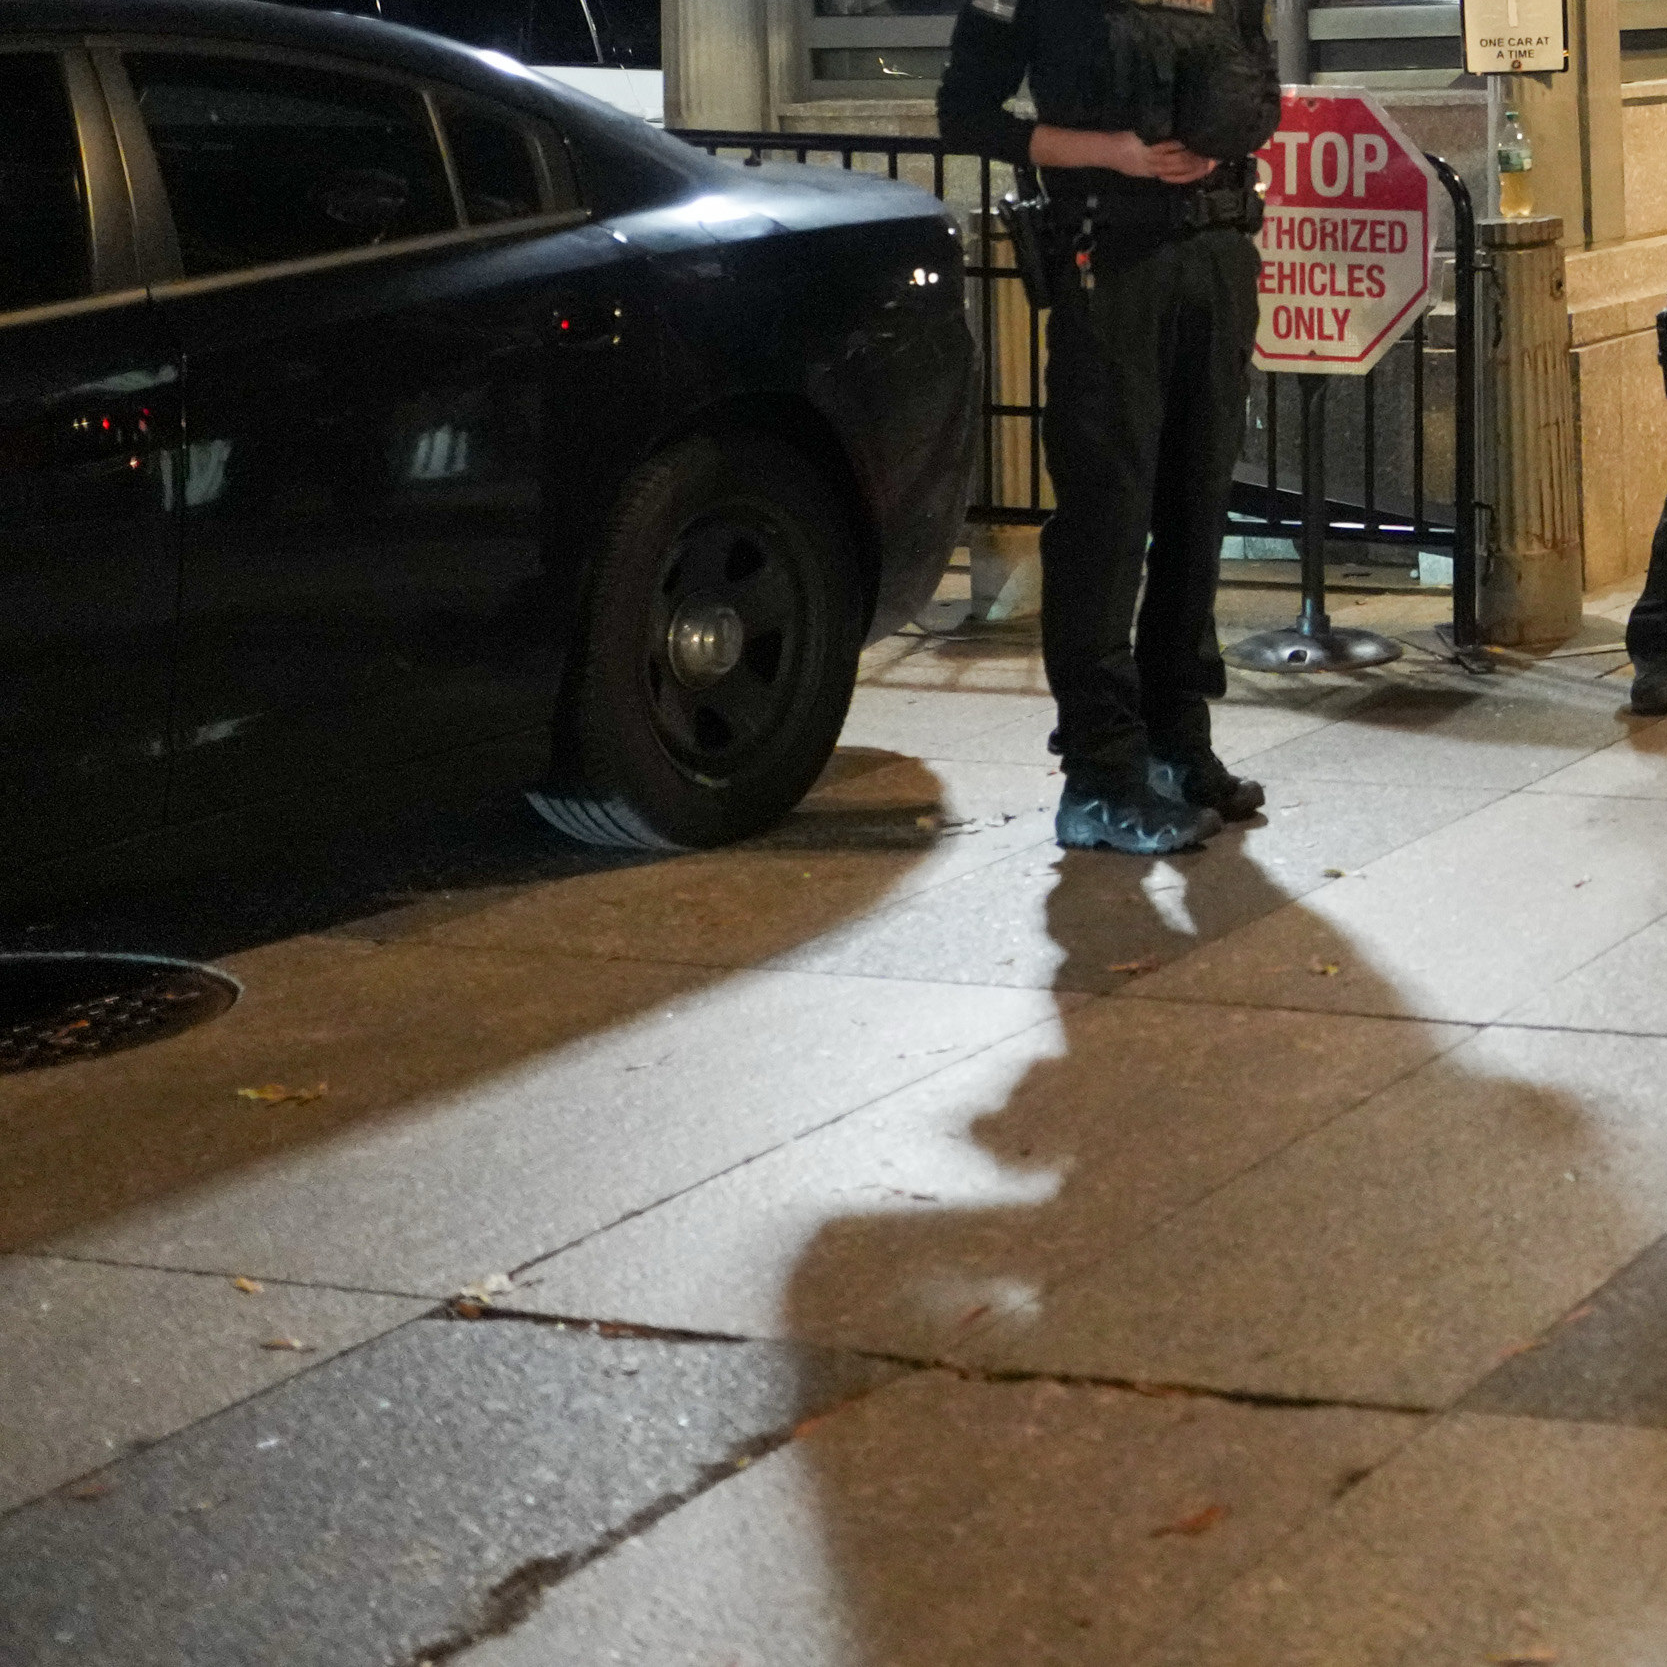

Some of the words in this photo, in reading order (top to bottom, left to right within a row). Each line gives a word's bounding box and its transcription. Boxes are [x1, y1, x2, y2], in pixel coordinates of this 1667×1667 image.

[1480, 38, 1505, 47] ONE
[1508, 37, 1532, 46] CAR
[1536, 36, 1550, 45] AT
[1496, 50, 1504, 59] A
[1508, 49, 1535, 59] TIME
[1262, 216, 1408, 254] THORIZED
[1258, 260, 1386, 298] EHICLES
[1272, 305, 1351, 341] ONLY
